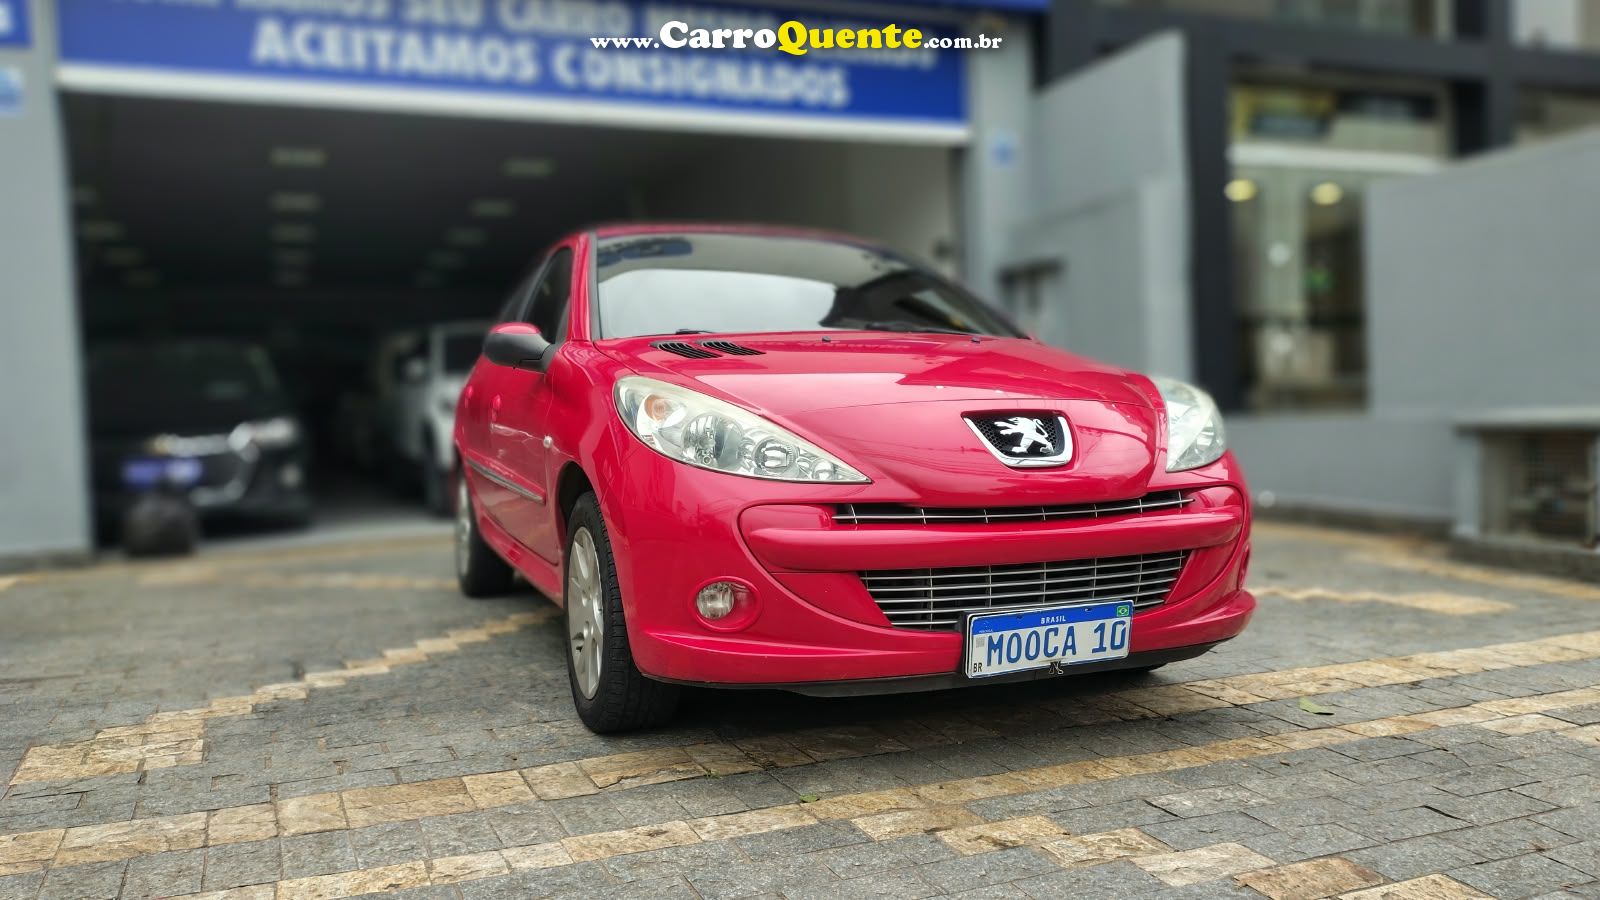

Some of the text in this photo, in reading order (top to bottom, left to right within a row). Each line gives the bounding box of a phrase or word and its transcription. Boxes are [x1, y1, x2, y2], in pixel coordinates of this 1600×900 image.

[254, 19, 538, 82] ACEITAMOS
[551, 45, 849, 107] CONSIGNADOS
[1040, 615, 1067, 624] BRASIL
[986, 625, 1077, 667] MOOCA
[973, 662, 983, 673] BR
